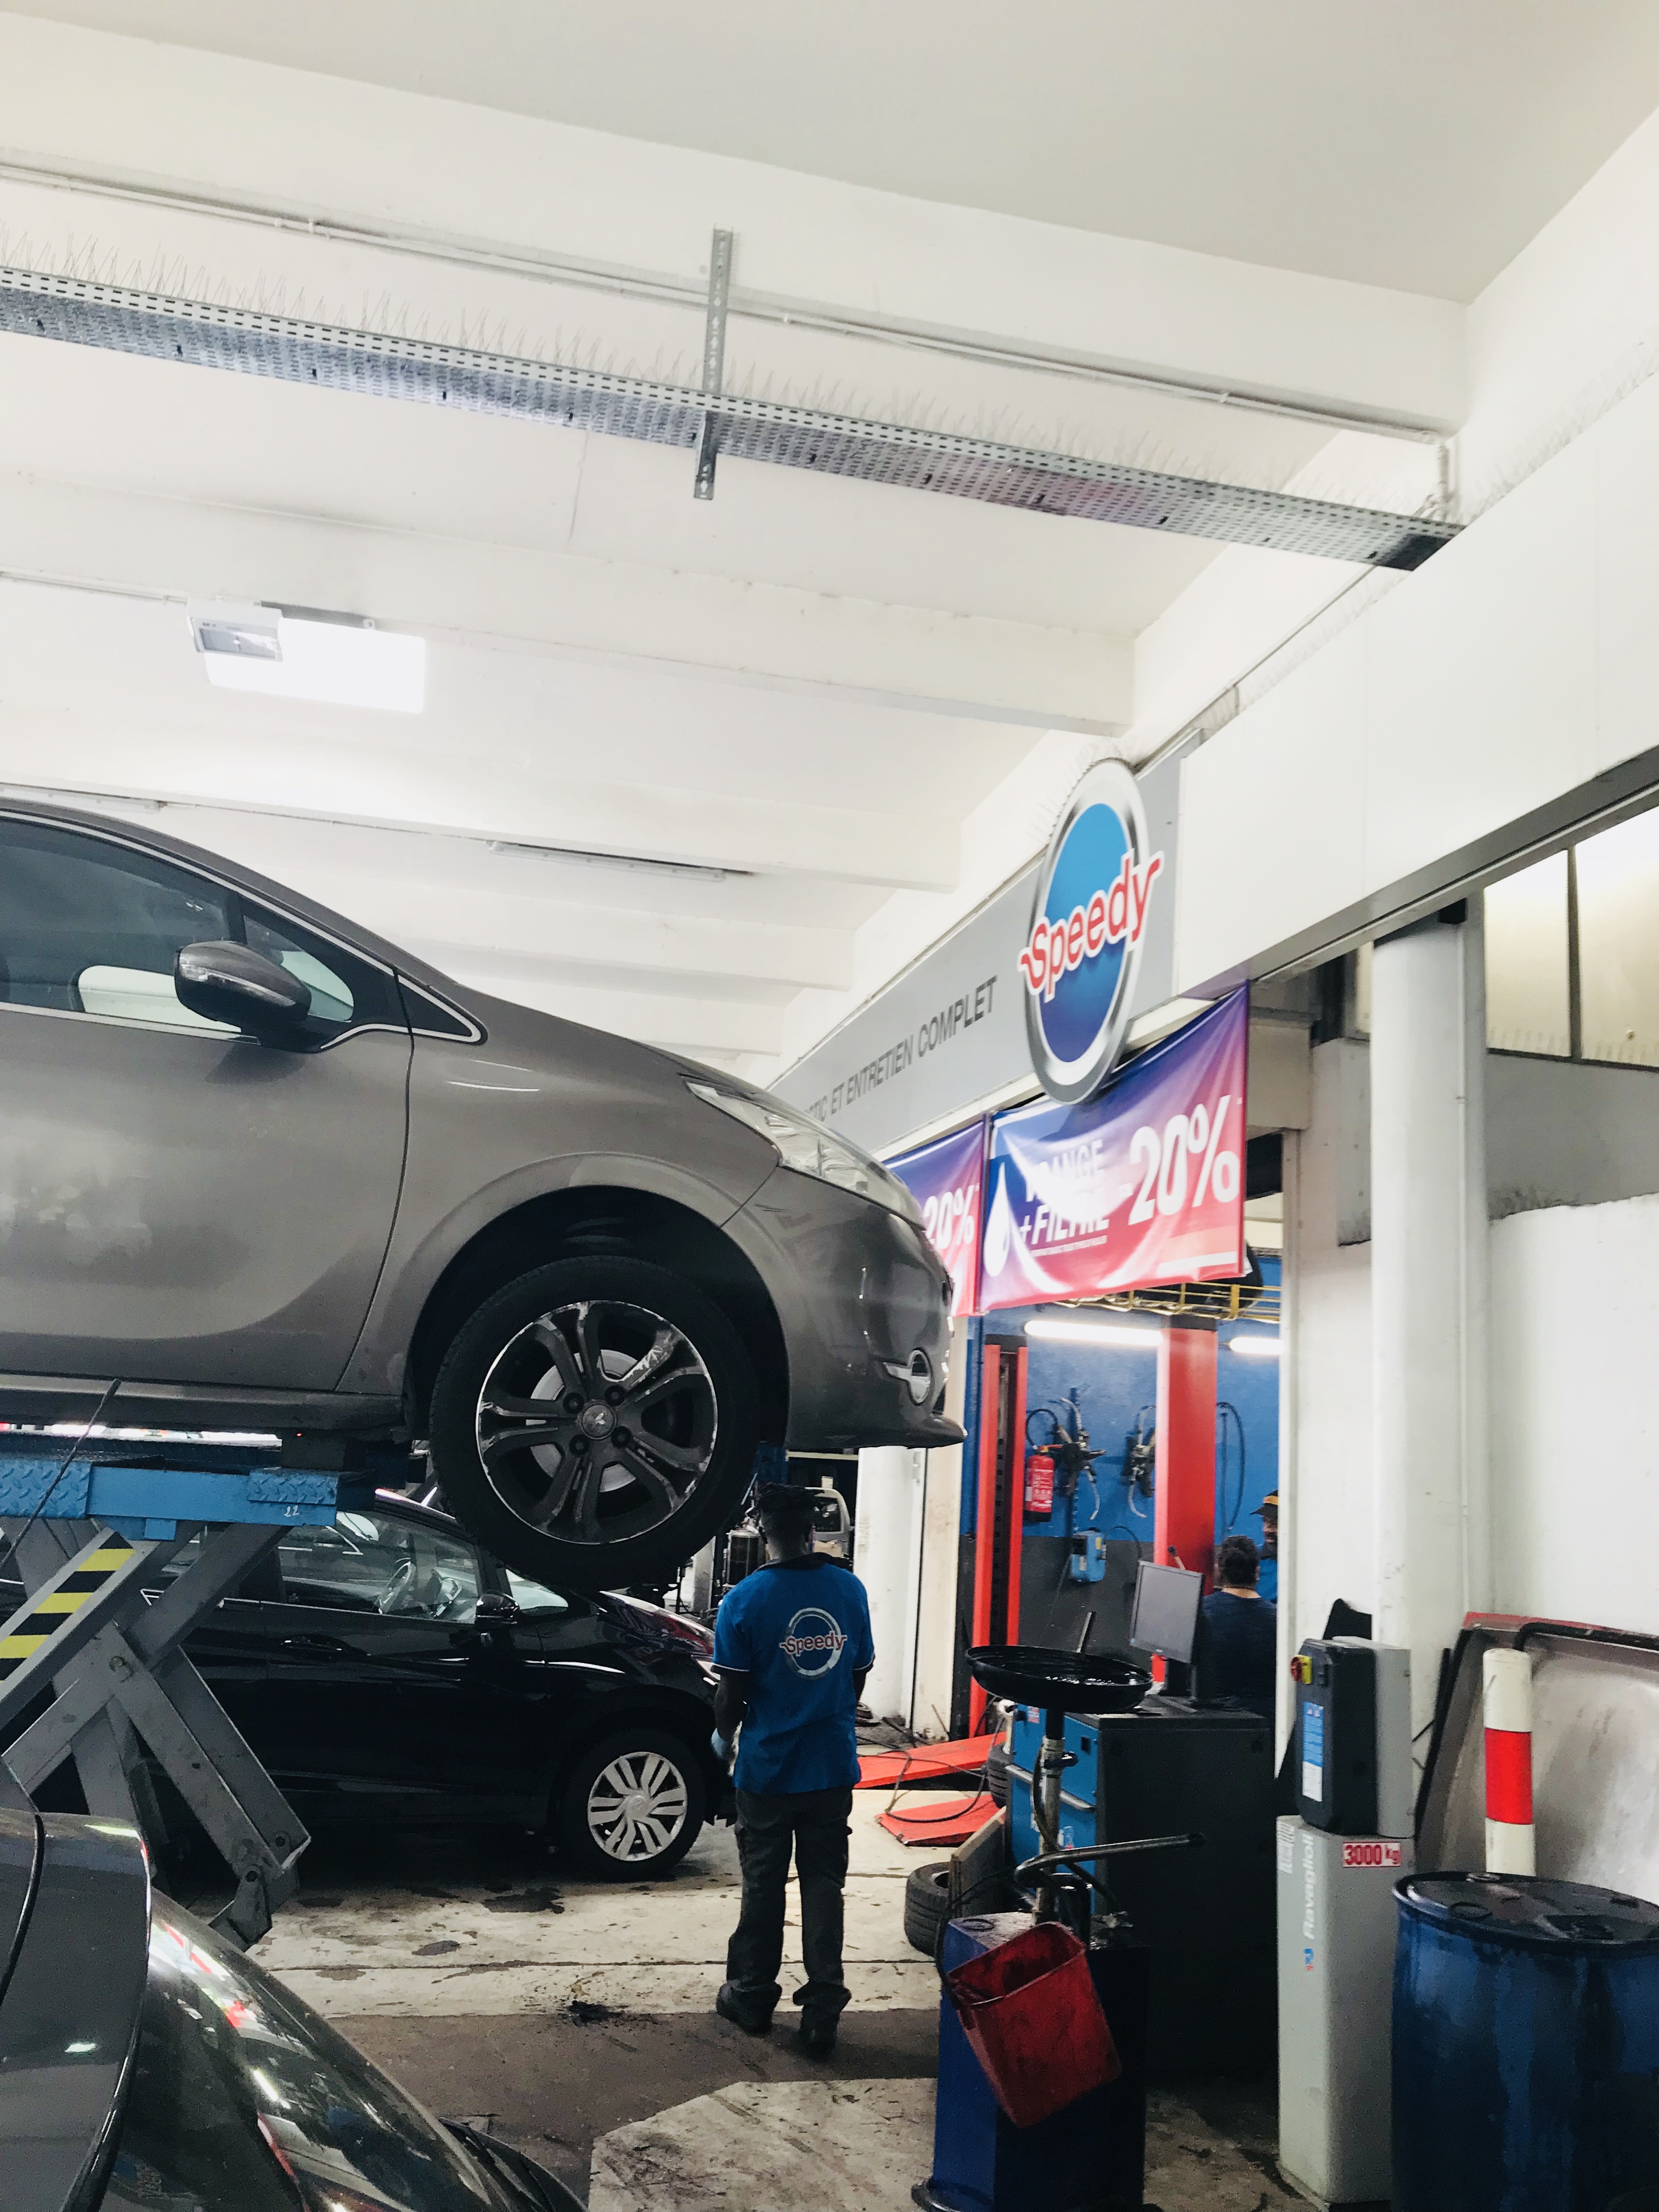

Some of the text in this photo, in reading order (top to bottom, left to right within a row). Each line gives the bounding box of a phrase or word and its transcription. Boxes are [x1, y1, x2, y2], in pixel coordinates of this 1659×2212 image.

[1018, 849, 1164, 1001] Speedy
[831, 1082, 845, 1115] ET
[846, 1034, 914, 1105] ENTRETIEN
[918, 974, 998, 1058] COMPLET
[779, 1630, 848, 1657] Speedy
[1345, 1844, 1382, 1865] 3000
